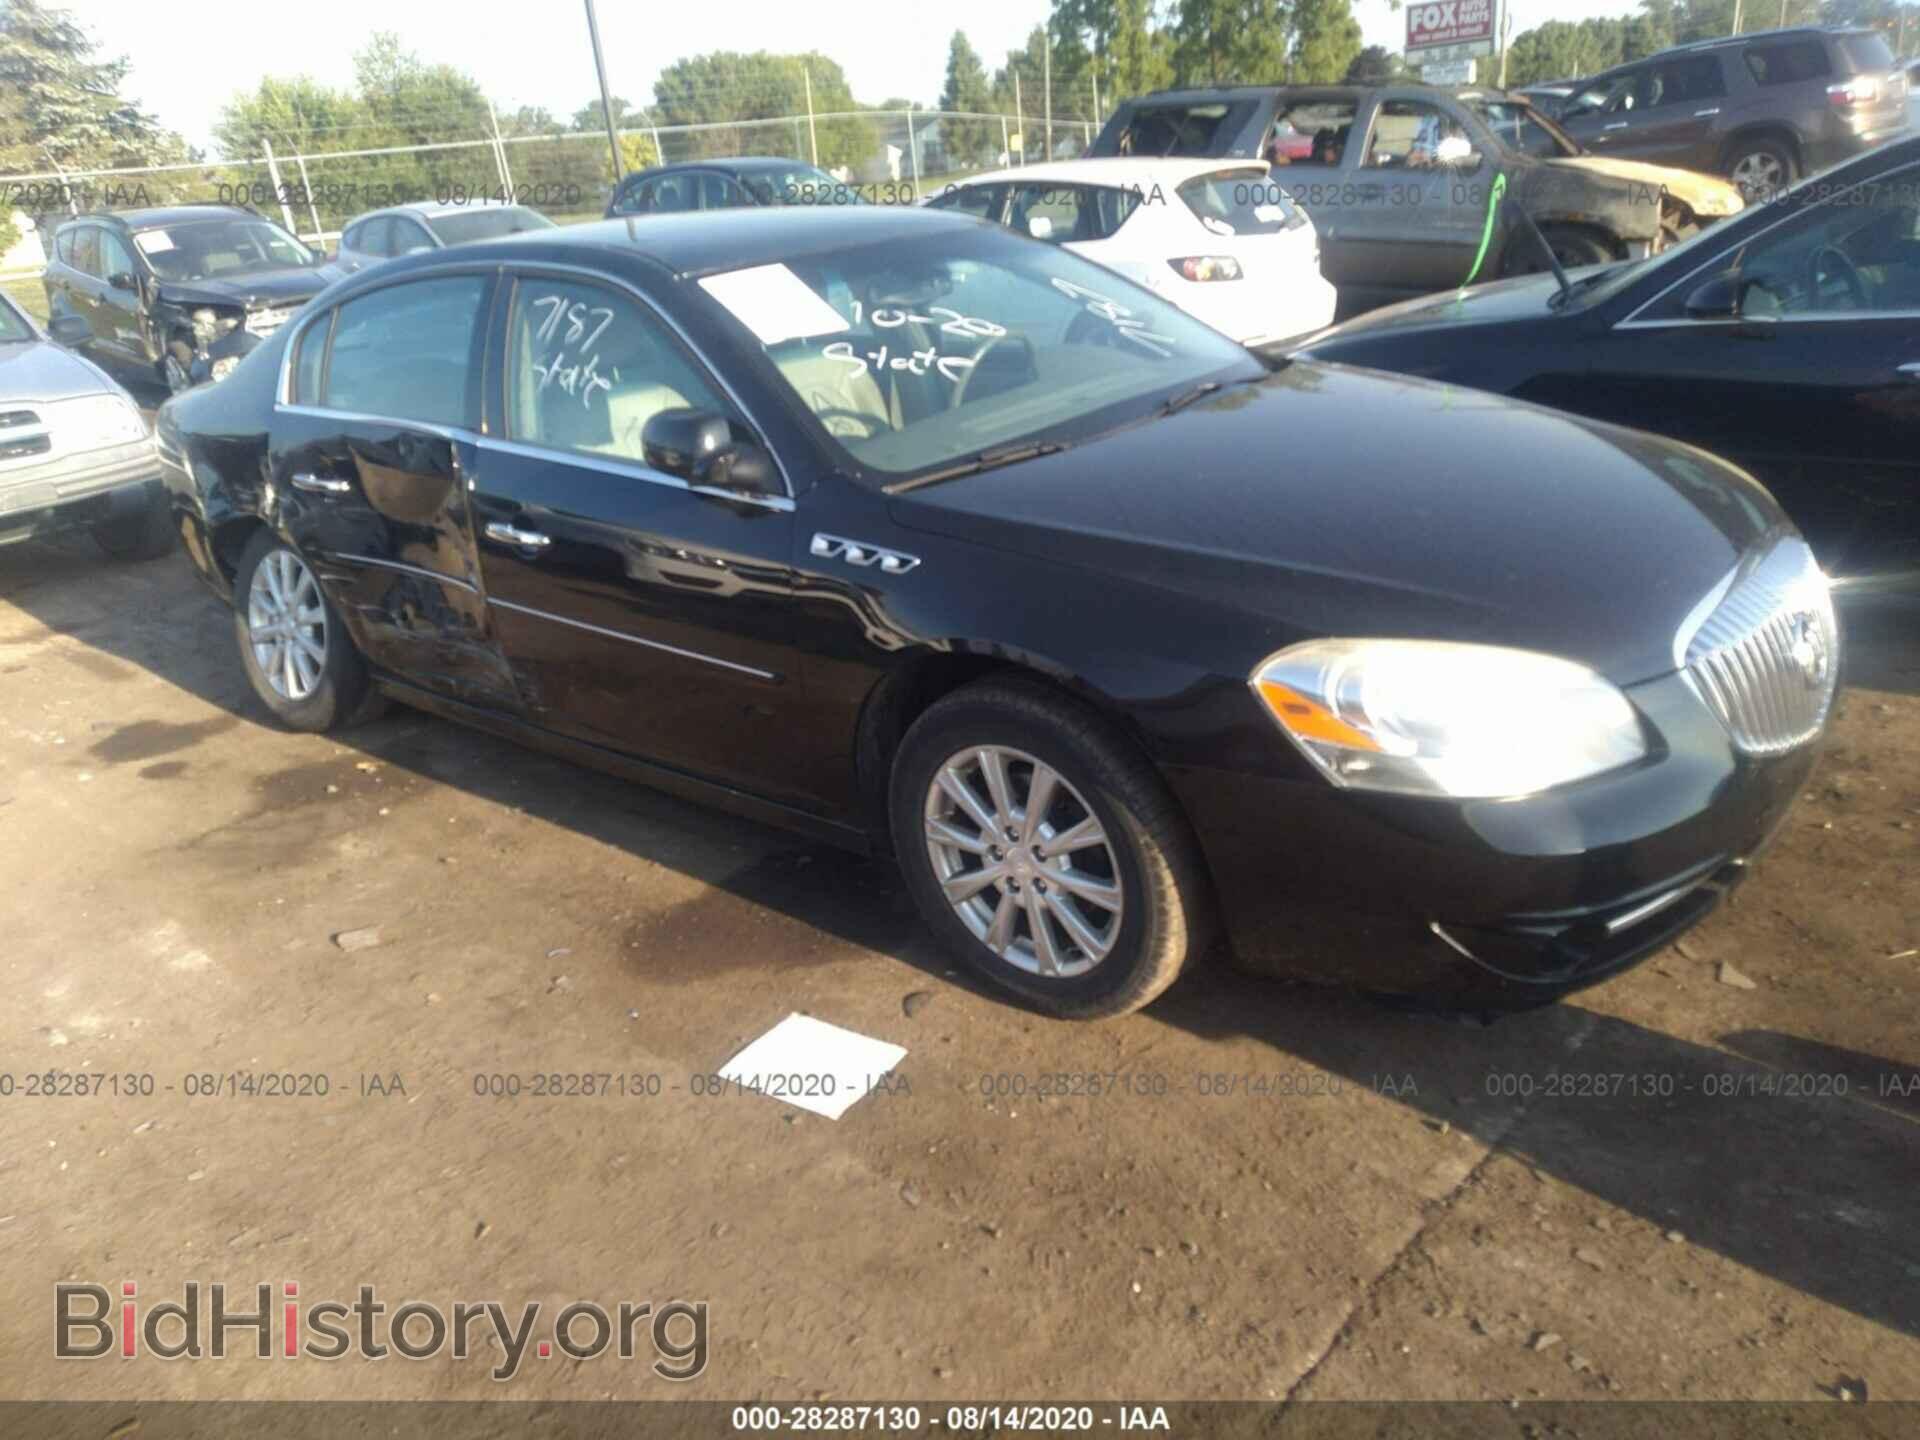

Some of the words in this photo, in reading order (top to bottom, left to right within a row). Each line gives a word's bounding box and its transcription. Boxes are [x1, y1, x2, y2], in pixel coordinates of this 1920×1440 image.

[1410, 3, 1456, 32] FOX
[1459, 9, 1489, 24] PARTS
[533, 295, 614, 354] 7187
